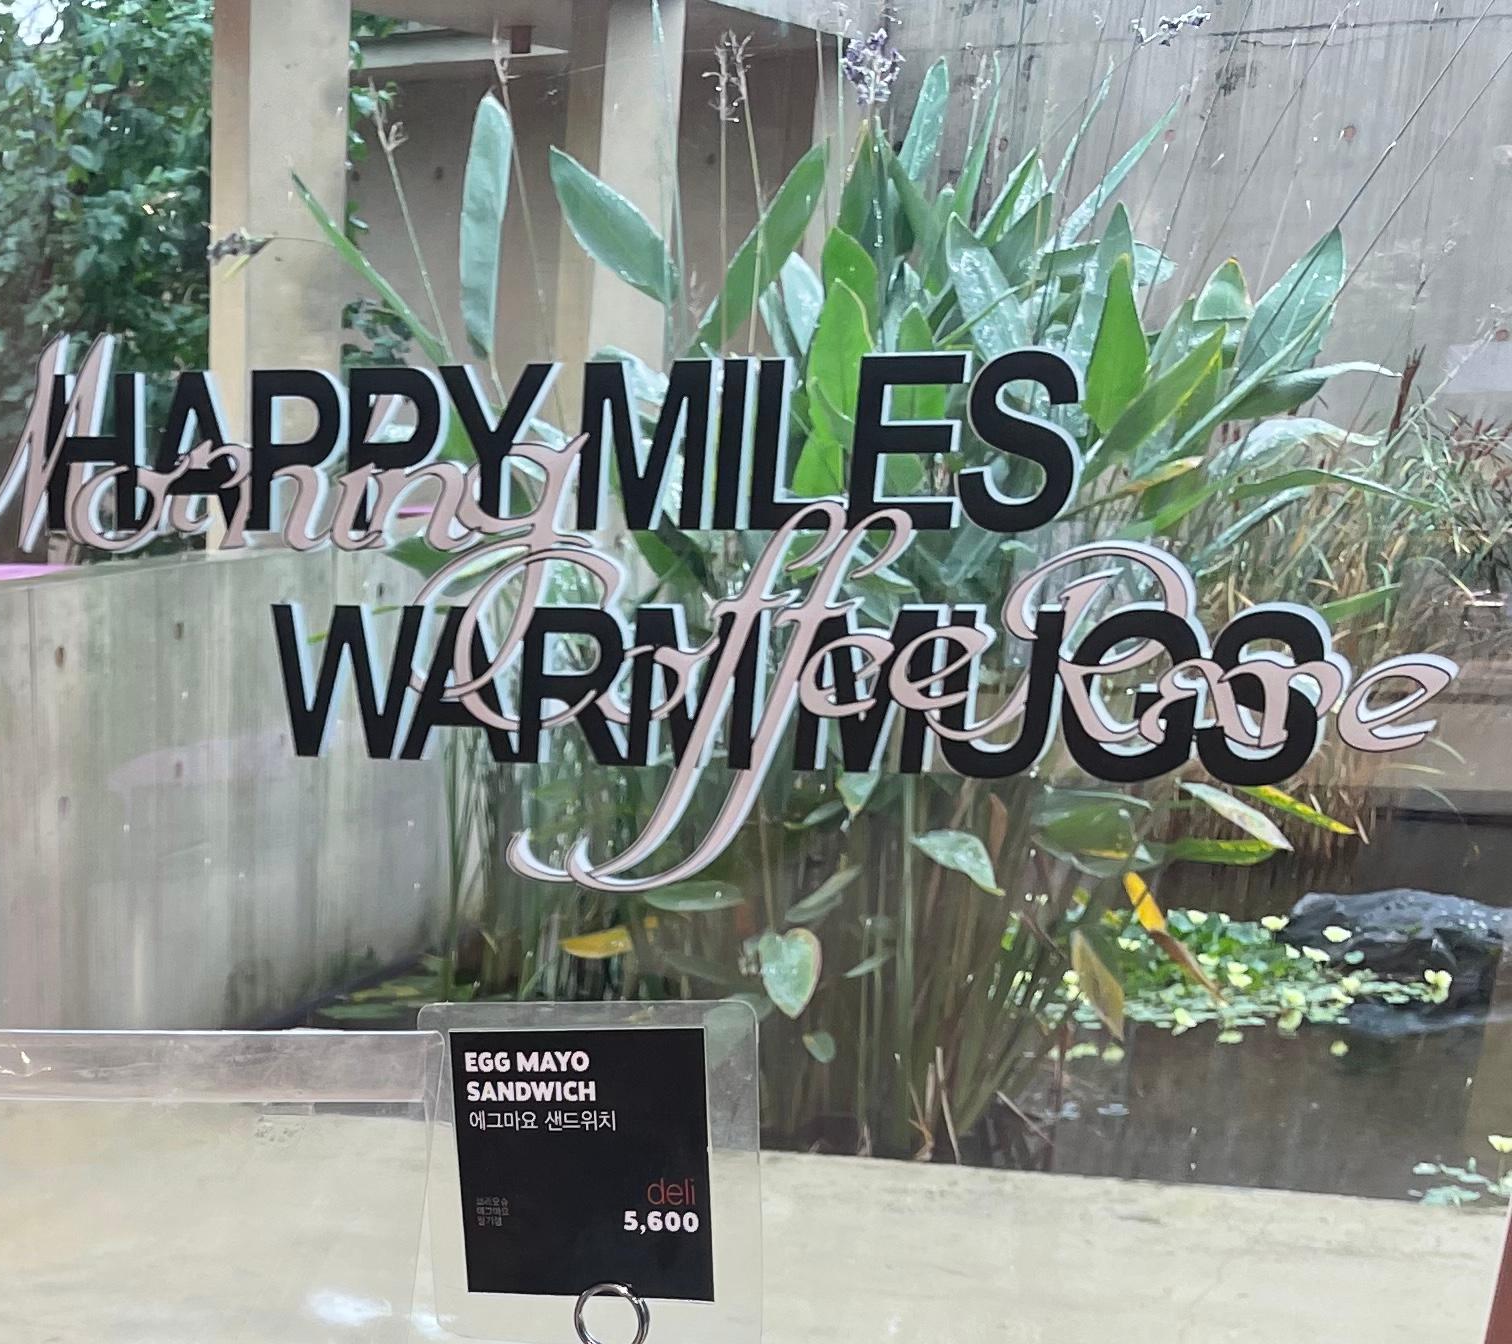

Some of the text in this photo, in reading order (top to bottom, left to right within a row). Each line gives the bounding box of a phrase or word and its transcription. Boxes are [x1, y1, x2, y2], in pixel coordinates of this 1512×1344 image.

[45, 348, 1083, 534] HAPPY MILES
[271, 602, 1333, 787] WARM MUGS
[464, 1051, 589, 1072] EGG MAYO
[467, 1081, 596, 1101] SANDWICH
[470, 1110, 616, 1131] 에그마요 샌드위치
[647, 1177, 696, 1206] deli
[624, 1211, 699, 1234] 5,600
